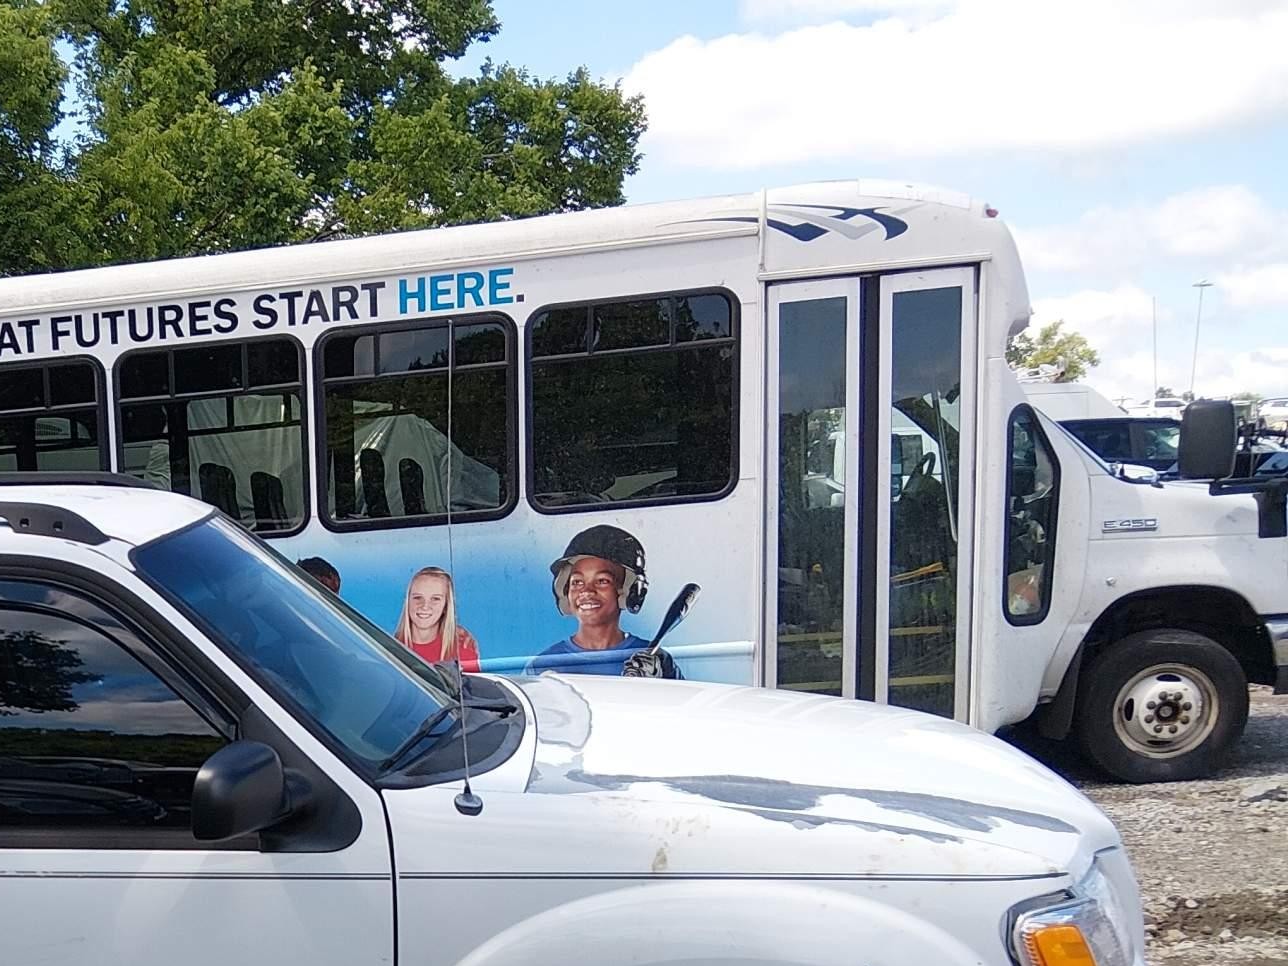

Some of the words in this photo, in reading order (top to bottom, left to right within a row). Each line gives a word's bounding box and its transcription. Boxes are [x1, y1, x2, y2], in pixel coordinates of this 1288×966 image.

[50, 298, 239, 351] FUTURES
[252, 281, 386, 330] START
[398, 267, 525, 315] HERE.
